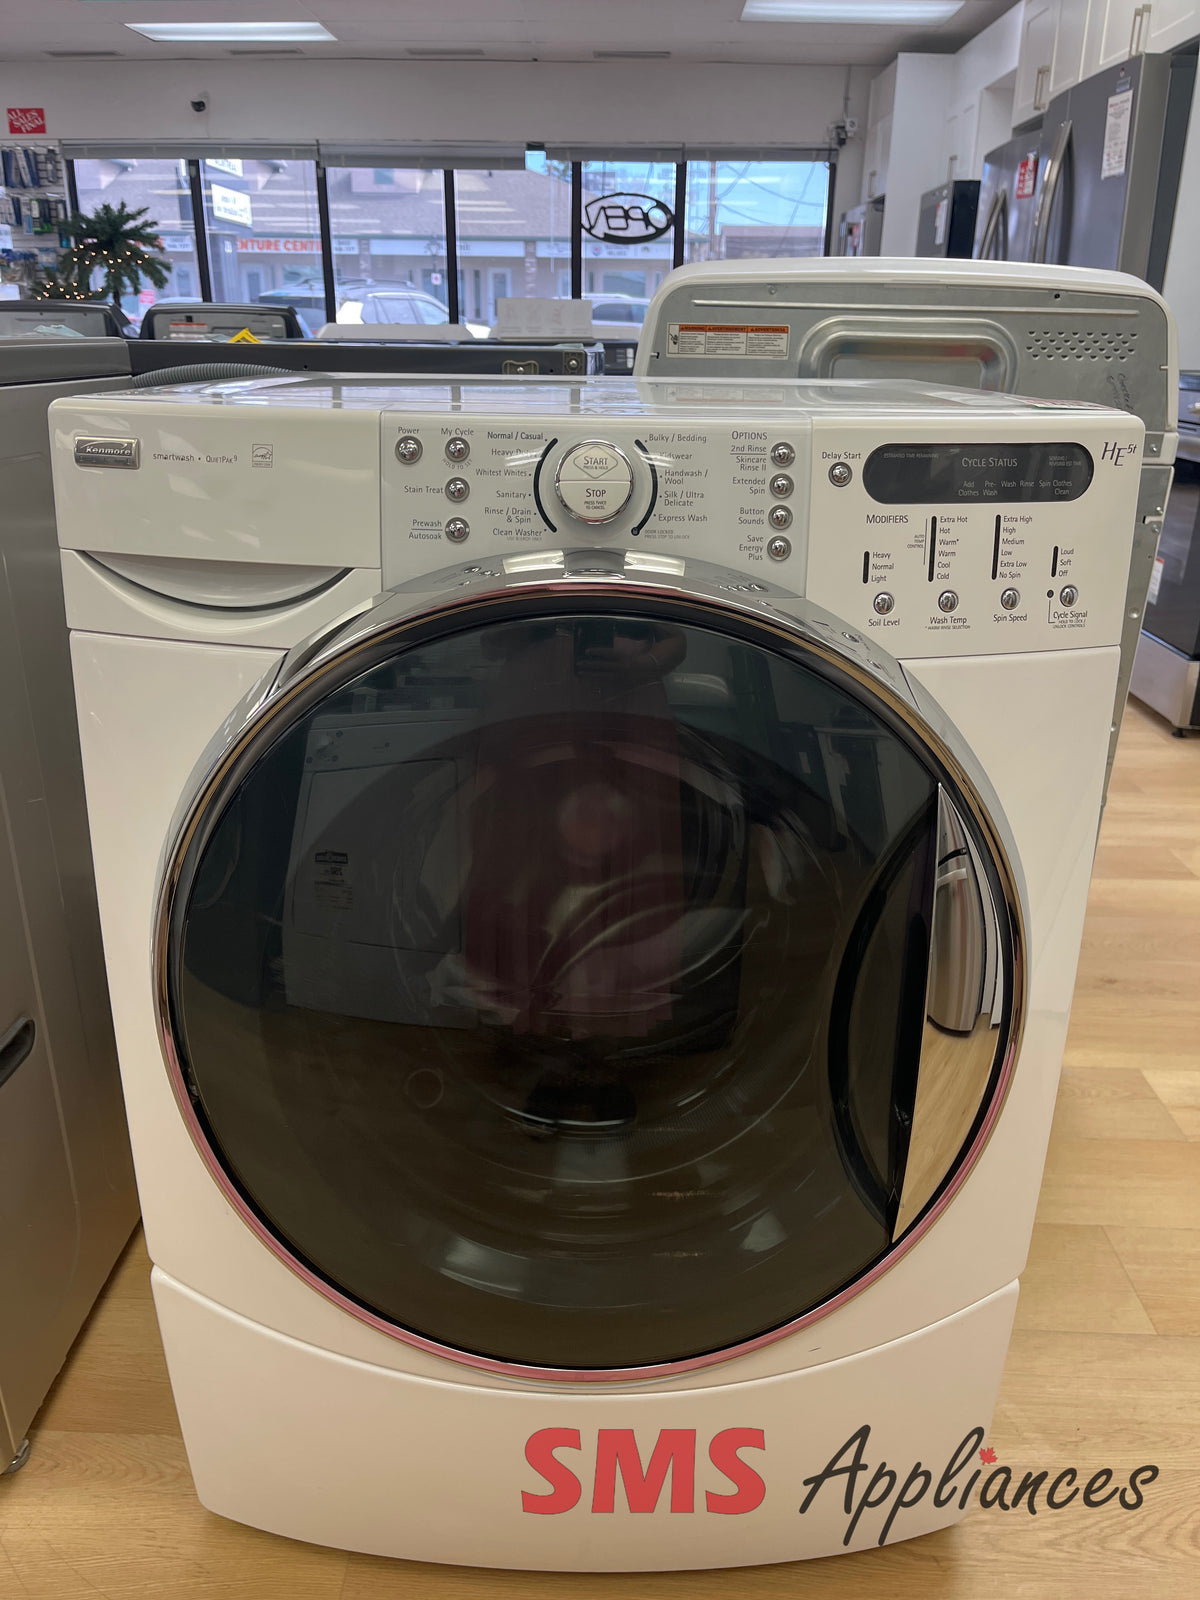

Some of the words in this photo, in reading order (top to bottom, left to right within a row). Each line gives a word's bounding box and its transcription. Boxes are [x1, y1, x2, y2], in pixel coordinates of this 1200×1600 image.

[398, 427, 420, 435] Power
[441, 428, 453, 436] My
[455, 428, 474, 437] Cycle
[487, 431, 513, 440] Normal
[520, 432, 544, 440] Casual
[731, 431, 768, 440] OPTIONS
[649, 434, 669, 443] Bulky
[677, 434, 707, 444] Bedding
[86, 446, 131, 455] Kenmore
[491, 448, 514, 456] Heavy
[153, 452, 194, 462] smartwash
[736, 456, 767, 464] Skincare
[822, 451, 841, 460] Delay
[843, 451, 861, 459] Start
[583, 456, 608, 466] START
[962, 457, 986, 467] CYCLE
[988, 457, 1018, 467] STATUS
[475, 469, 501, 477] Whitest
[504, 469, 527, 477] Whites
[664, 469, 702, 477] Handwash
[732, 477, 766, 485] Extended
[1039, 480, 1051, 489] Spin
[404, 485, 423, 493] Stain
[426, 486, 444, 494] Treat
[586, 488, 607, 498] STOP
[749, 487, 765, 495] Spin
[496, 490, 527, 499] Sanitary
[664, 499, 694, 507] Delicate
[485, 507, 504, 515] Rinse
[511, 507, 531, 515] Drain
[740, 507, 765, 515] Button
[412, 519, 442, 527] Prewash
[515, 516, 531, 524] Spin
[658, 514, 685, 523] Express
[687, 514, 708, 522] Wash
[738, 517, 765, 525] Sounds
[866, 514, 909, 524] MODIFIERS
[1003, 515, 1018, 523] Extra
[1020, 515, 1033, 524] High
[408, 531, 442, 540] Autosoak
[493, 528, 513, 536] Clean
[515, 529, 542, 537] Washer
[1003, 527, 1016, 535] High
[747, 535, 764, 543] Save
[739, 544, 763, 553] Energy
[748, 553, 763, 561] Plus
[937, 561, 951, 569] Cool
[871, 575, 887, 584] Light
[1009, 571, 1021, 579] Spin
[993, 613, 1007, 623] Spin
[1010, 613, 1028, 622] Speed
[1053, 611, 1069, 620] Cycle
[1070, 610, 1088, 619] Signal
[868, 618, 881, 627] Soil
[883, 618, 900, 626] Level
[930, 616, 948, 624] Wash
[950, 616, 967, 625] Temp
